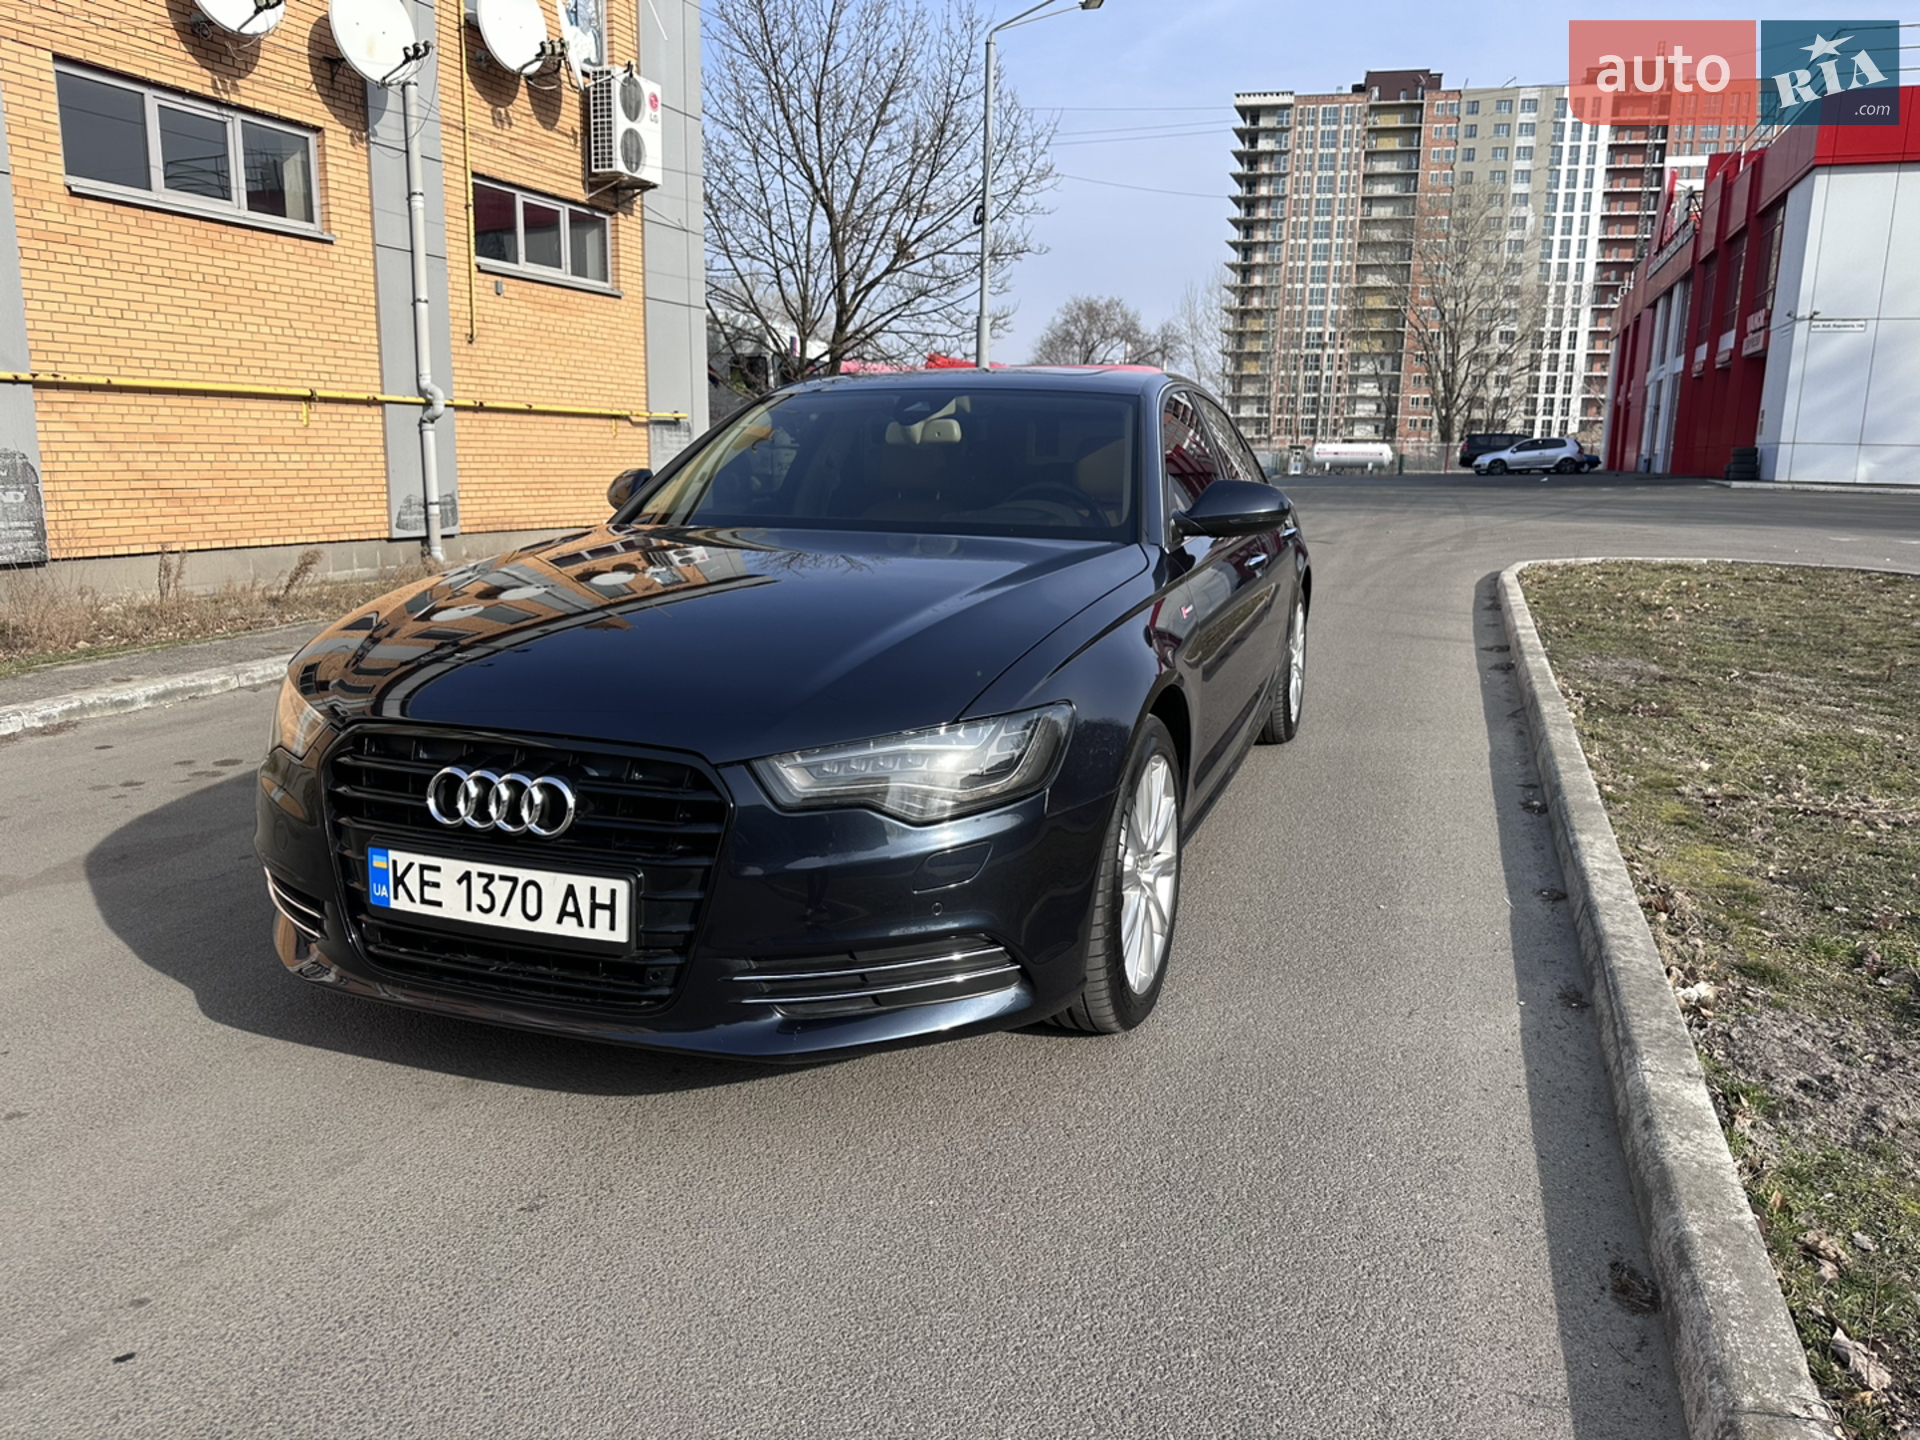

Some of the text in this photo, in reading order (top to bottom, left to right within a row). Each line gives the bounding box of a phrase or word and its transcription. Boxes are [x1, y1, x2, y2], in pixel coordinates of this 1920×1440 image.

[373, 882, 389, 898] UA
[392, 858, 617, 932] KE 1370 AH
